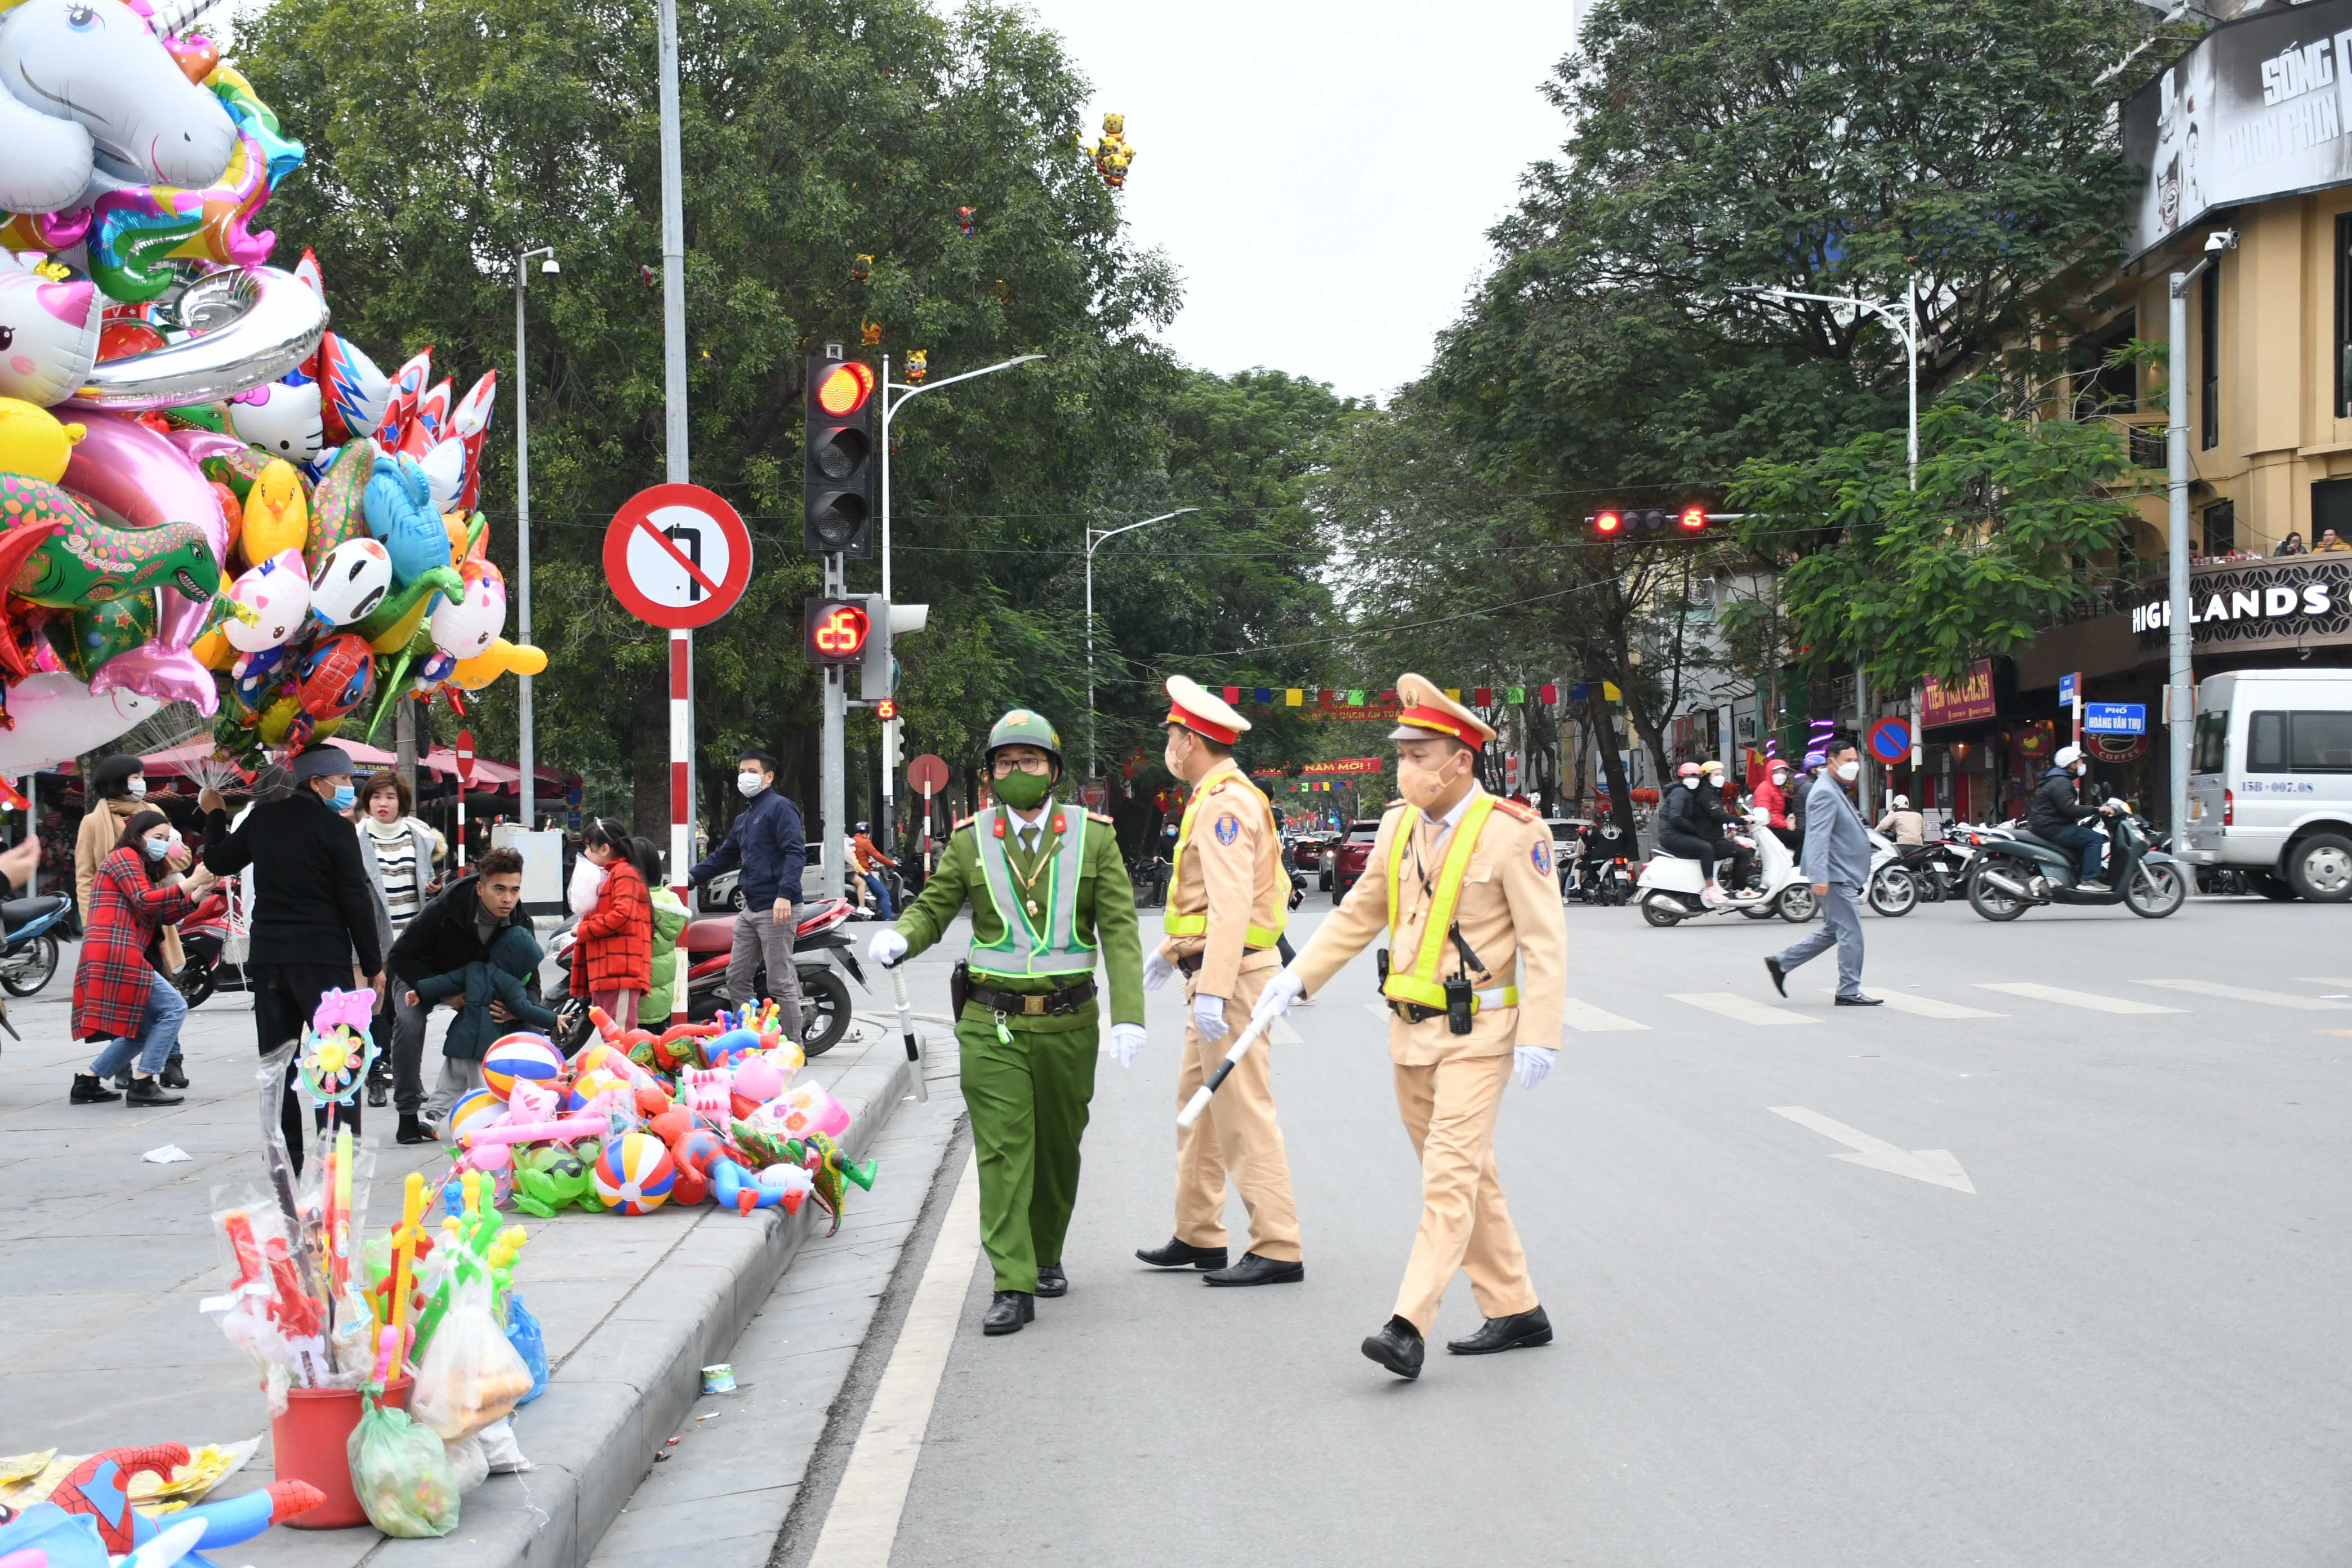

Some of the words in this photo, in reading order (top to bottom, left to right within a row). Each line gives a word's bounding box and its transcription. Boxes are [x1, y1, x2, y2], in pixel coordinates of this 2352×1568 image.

[2261, 38, 2334, 107] SỐNG
[2283, 92, 2340, 154] PHIN
[1684, 511, 1701, 526] 25
[61, 534, 137, 573] Dinosaur
[879, 702, 893, 716] 25
[2105, 706, 2128, 714] PHỐ
[2089, 715, 2112, 729] HOÀNG
[2113, 716, 2127, 729] VĂN
[2128, 718, 2141, 731] THỤ
[2099, 747, 2141, 760] COFFEE
